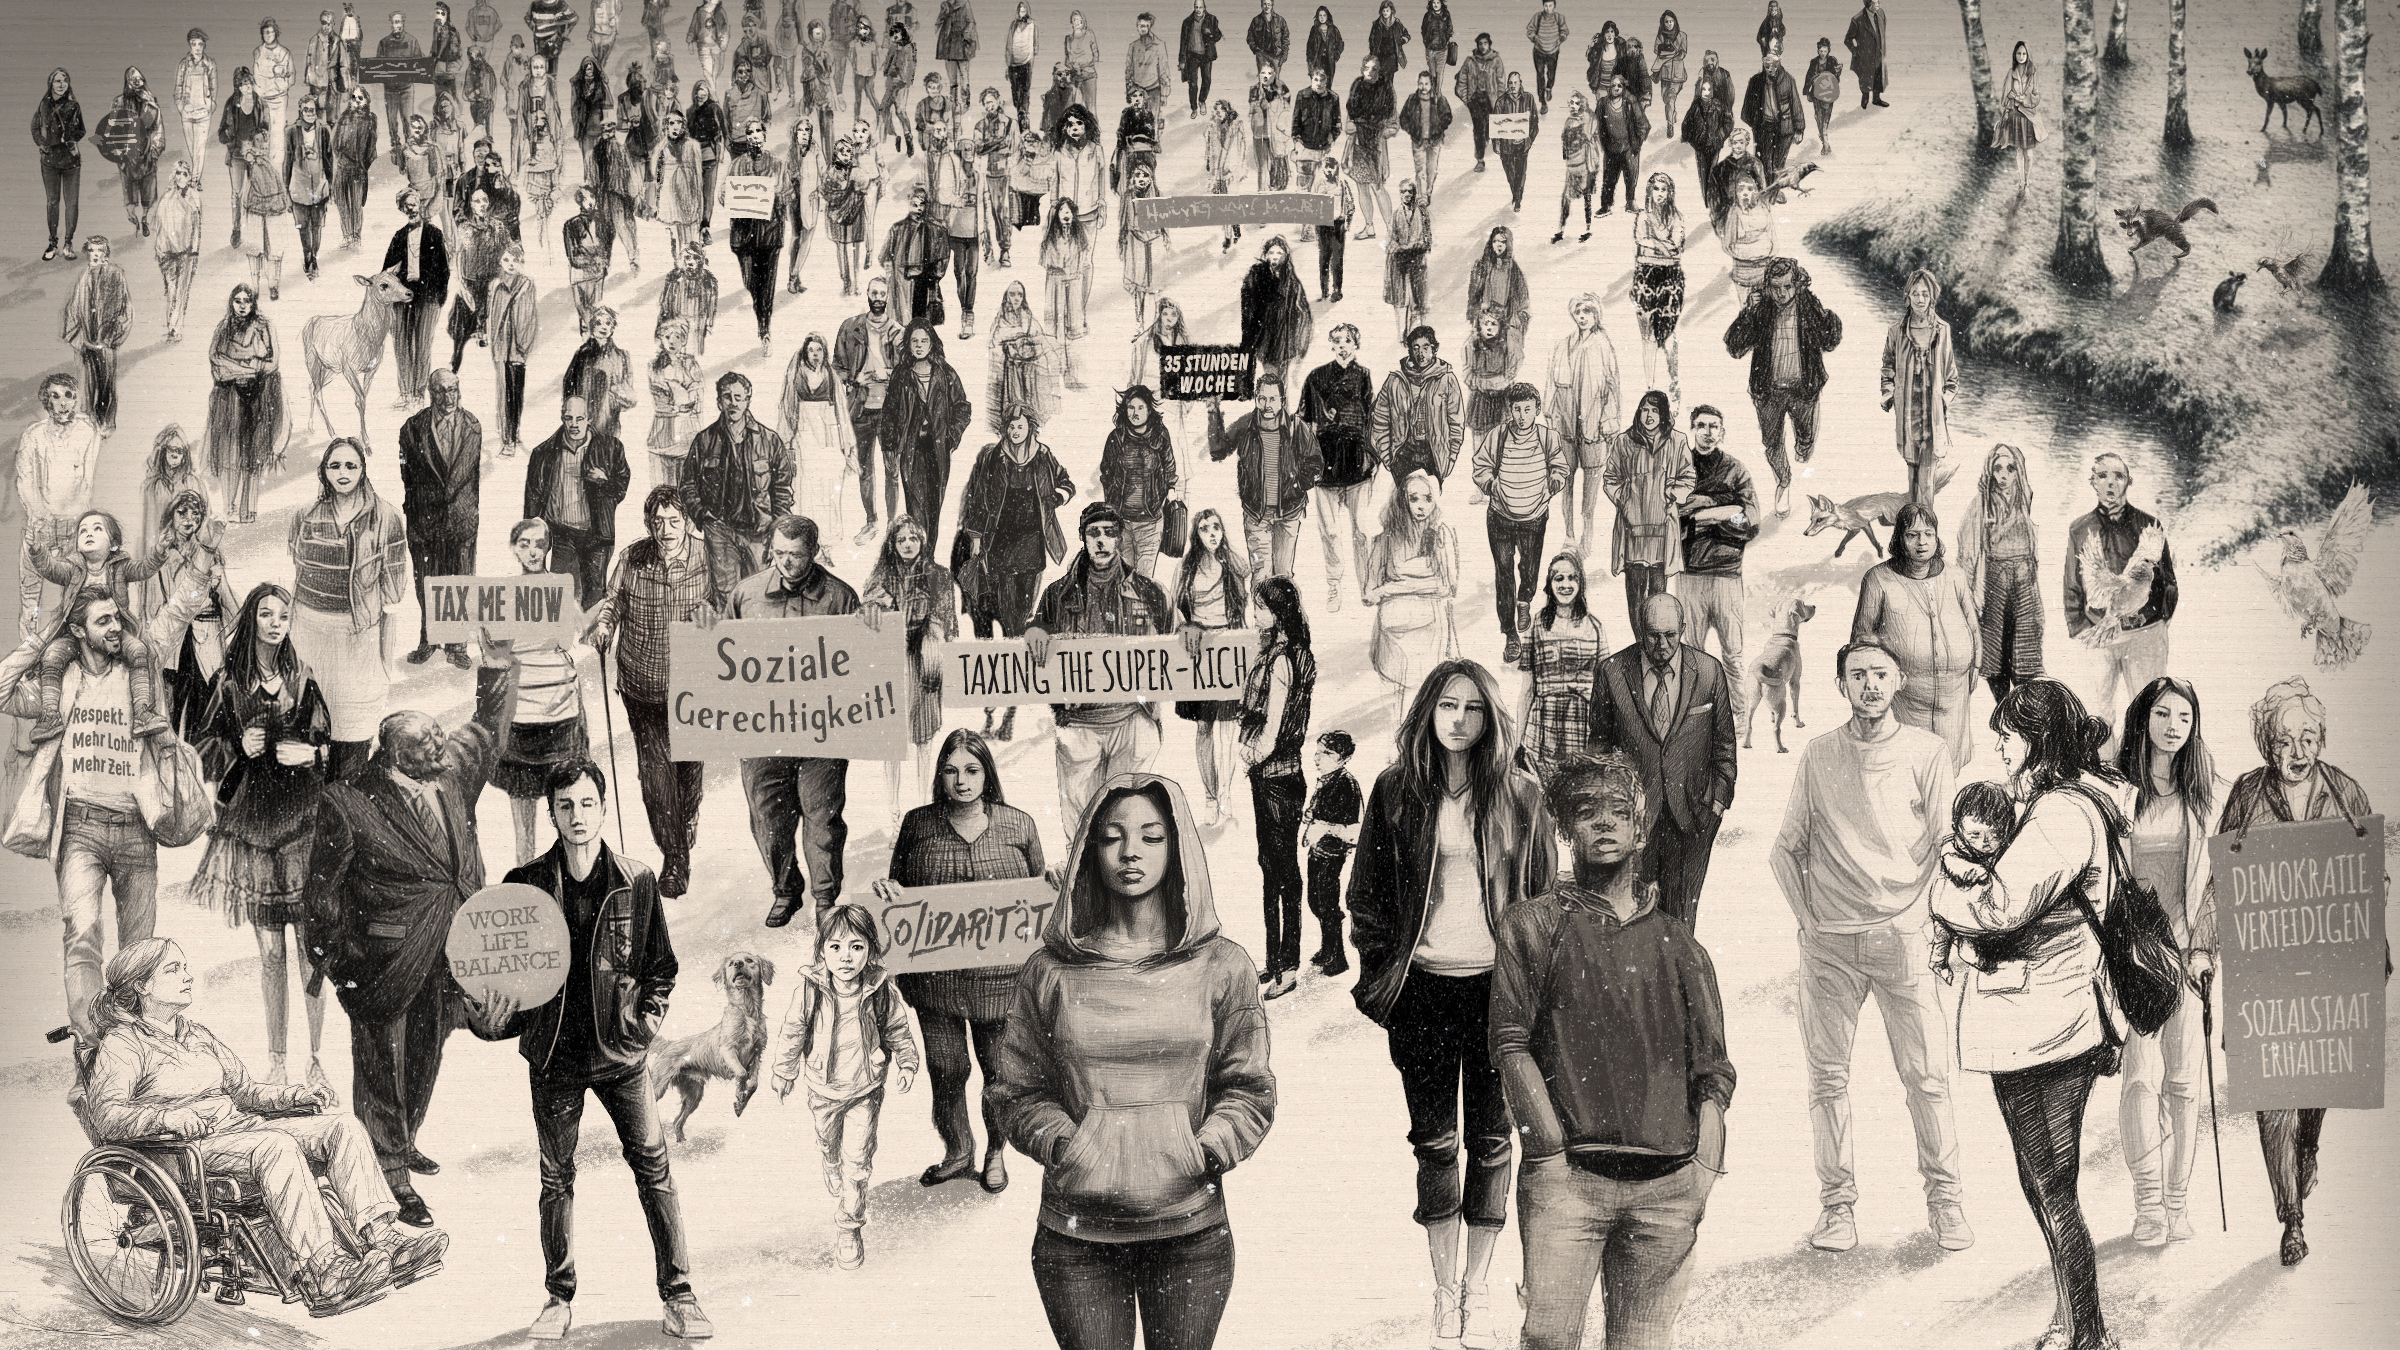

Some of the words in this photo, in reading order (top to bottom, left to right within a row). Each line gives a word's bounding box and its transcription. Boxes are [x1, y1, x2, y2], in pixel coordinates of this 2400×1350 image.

[1164, 354, 1182, 373] 35
[1184, 352, 1250, 373] STUNDEN
[1180, 374, 1236, 394] WOCHE
[431, 585, 470, 622] TAX
[478, 585, 506, 622] ME
[515, 585, 564, 623] NOW
[716, 635, 850, 683] Soziale
[958, 650, 1051, 696] TAXING
[1056, 650, 1096, 693] THE
[72, 707, 128, 726] Respekt.
[674, 680, 896, 744] Gerechtigkeit!
[72, 730, 106, 750] Mehr
[107, 732, 138, 753] Lohn.
[72, 755, 107, 774] Mehr
[107, 757, 136, 777] Zeit.
[2232, 853, 2370, 906] DEMOKRATIE
[466, 905, 540, 930] WORK
[2233, 899, 2370, 951] VERTEIDIGEN
[481, 930, 529, 952] LIFE
[452, 950, 562, 978] BALANCE
[2241, 992, 2370, 1039] SOZIALSTAAT
[2261, 1036, 2354, 1078] ERHALTEN
